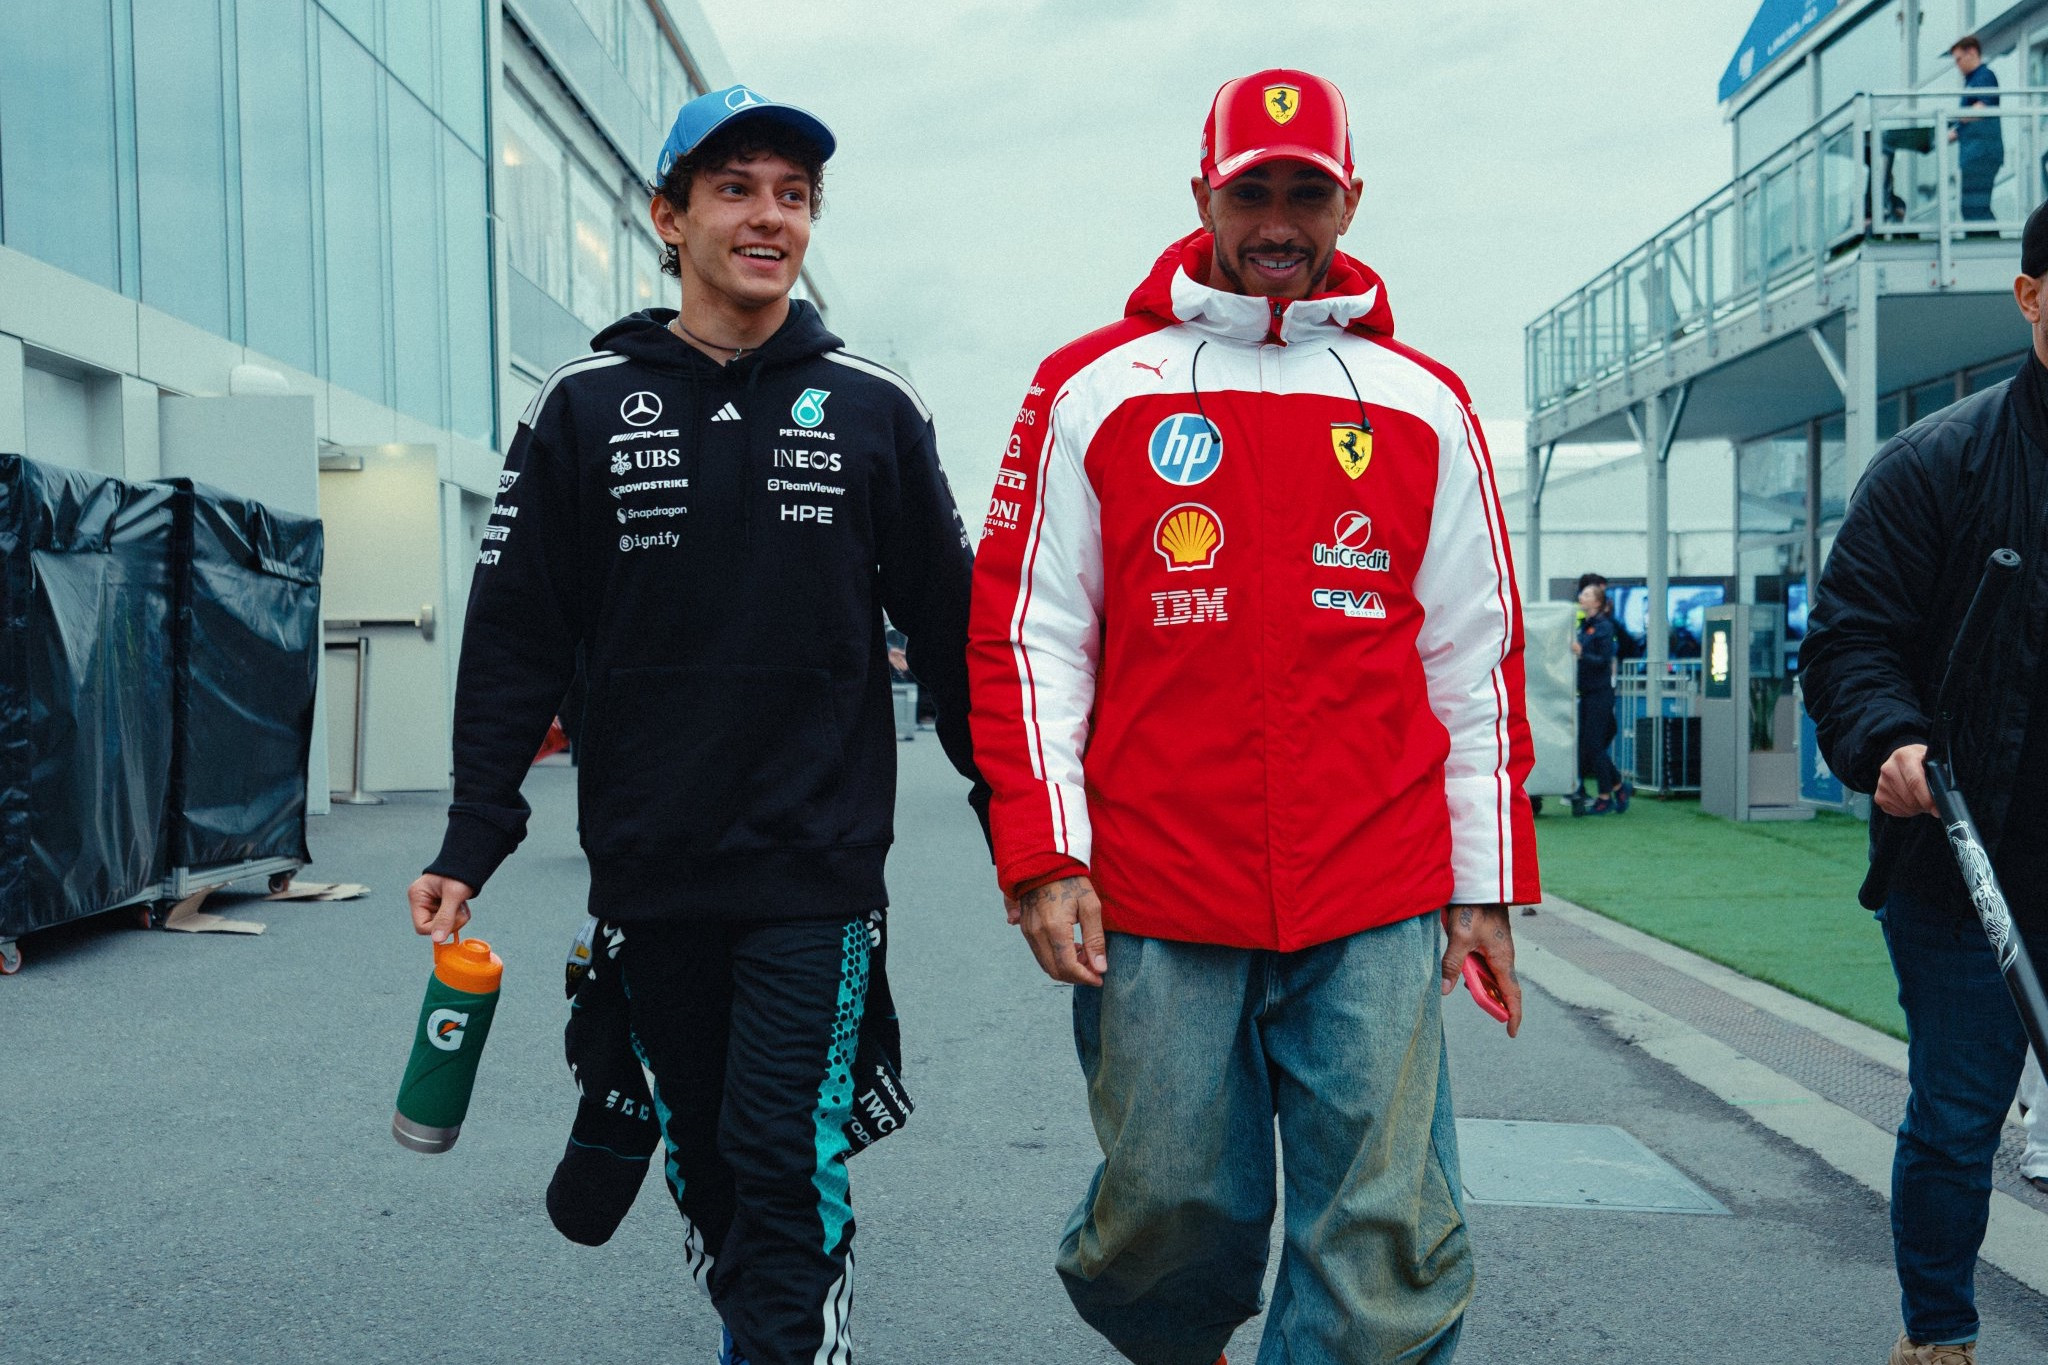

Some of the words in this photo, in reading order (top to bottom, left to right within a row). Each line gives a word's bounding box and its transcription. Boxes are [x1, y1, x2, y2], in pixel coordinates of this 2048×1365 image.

[628, 429, 679, 440] AMG
[779, 428, 835, 441] PETRONAS
[634, 448, 681, 469] UBS
[1160, 415, 1214, 483] hp
[773, 448, 842, 472] INEOS
[613, 478, 689, 496] CROWDSTRIKE
[780, 480, 846, 496] TeamViewer
[627, 505, 687, 521] Snapdragon
[780, 504, 833, 524] HPE
[1314, 545, 1388, 570] UniCredit
[1151, 587, 1228, 626] IBM
[427, 1008, 469, 1051] G
[858, 1088, 897, 1133] IWC
